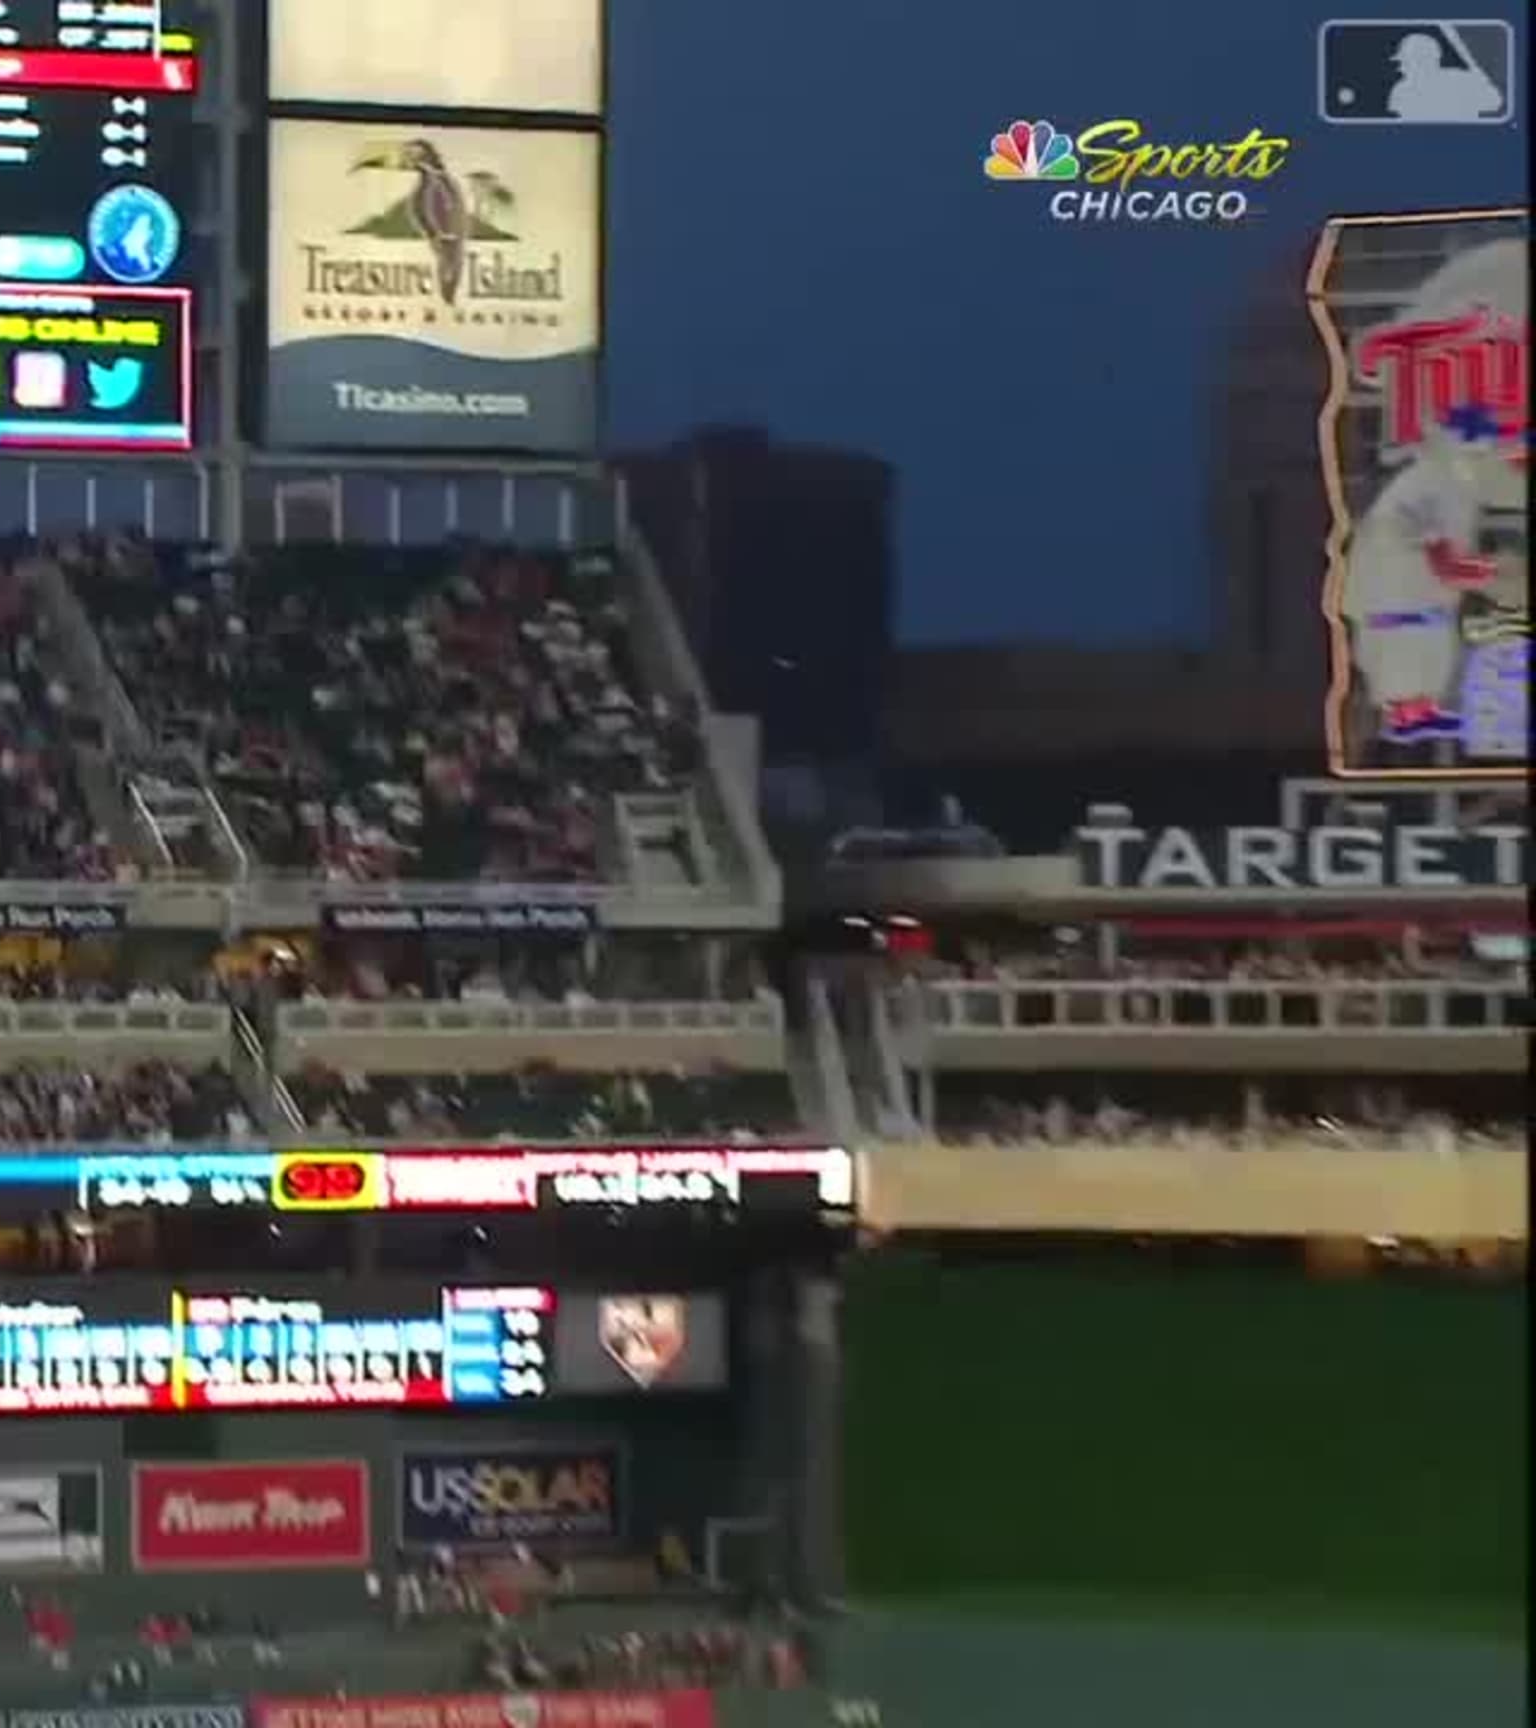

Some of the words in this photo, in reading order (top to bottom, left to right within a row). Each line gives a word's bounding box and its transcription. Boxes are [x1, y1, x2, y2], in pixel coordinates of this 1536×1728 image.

[300, 244, 434, 298] Treasure
[467, 250, 564, 301] Island
[1076, 825, 1528, 887] TARGET
